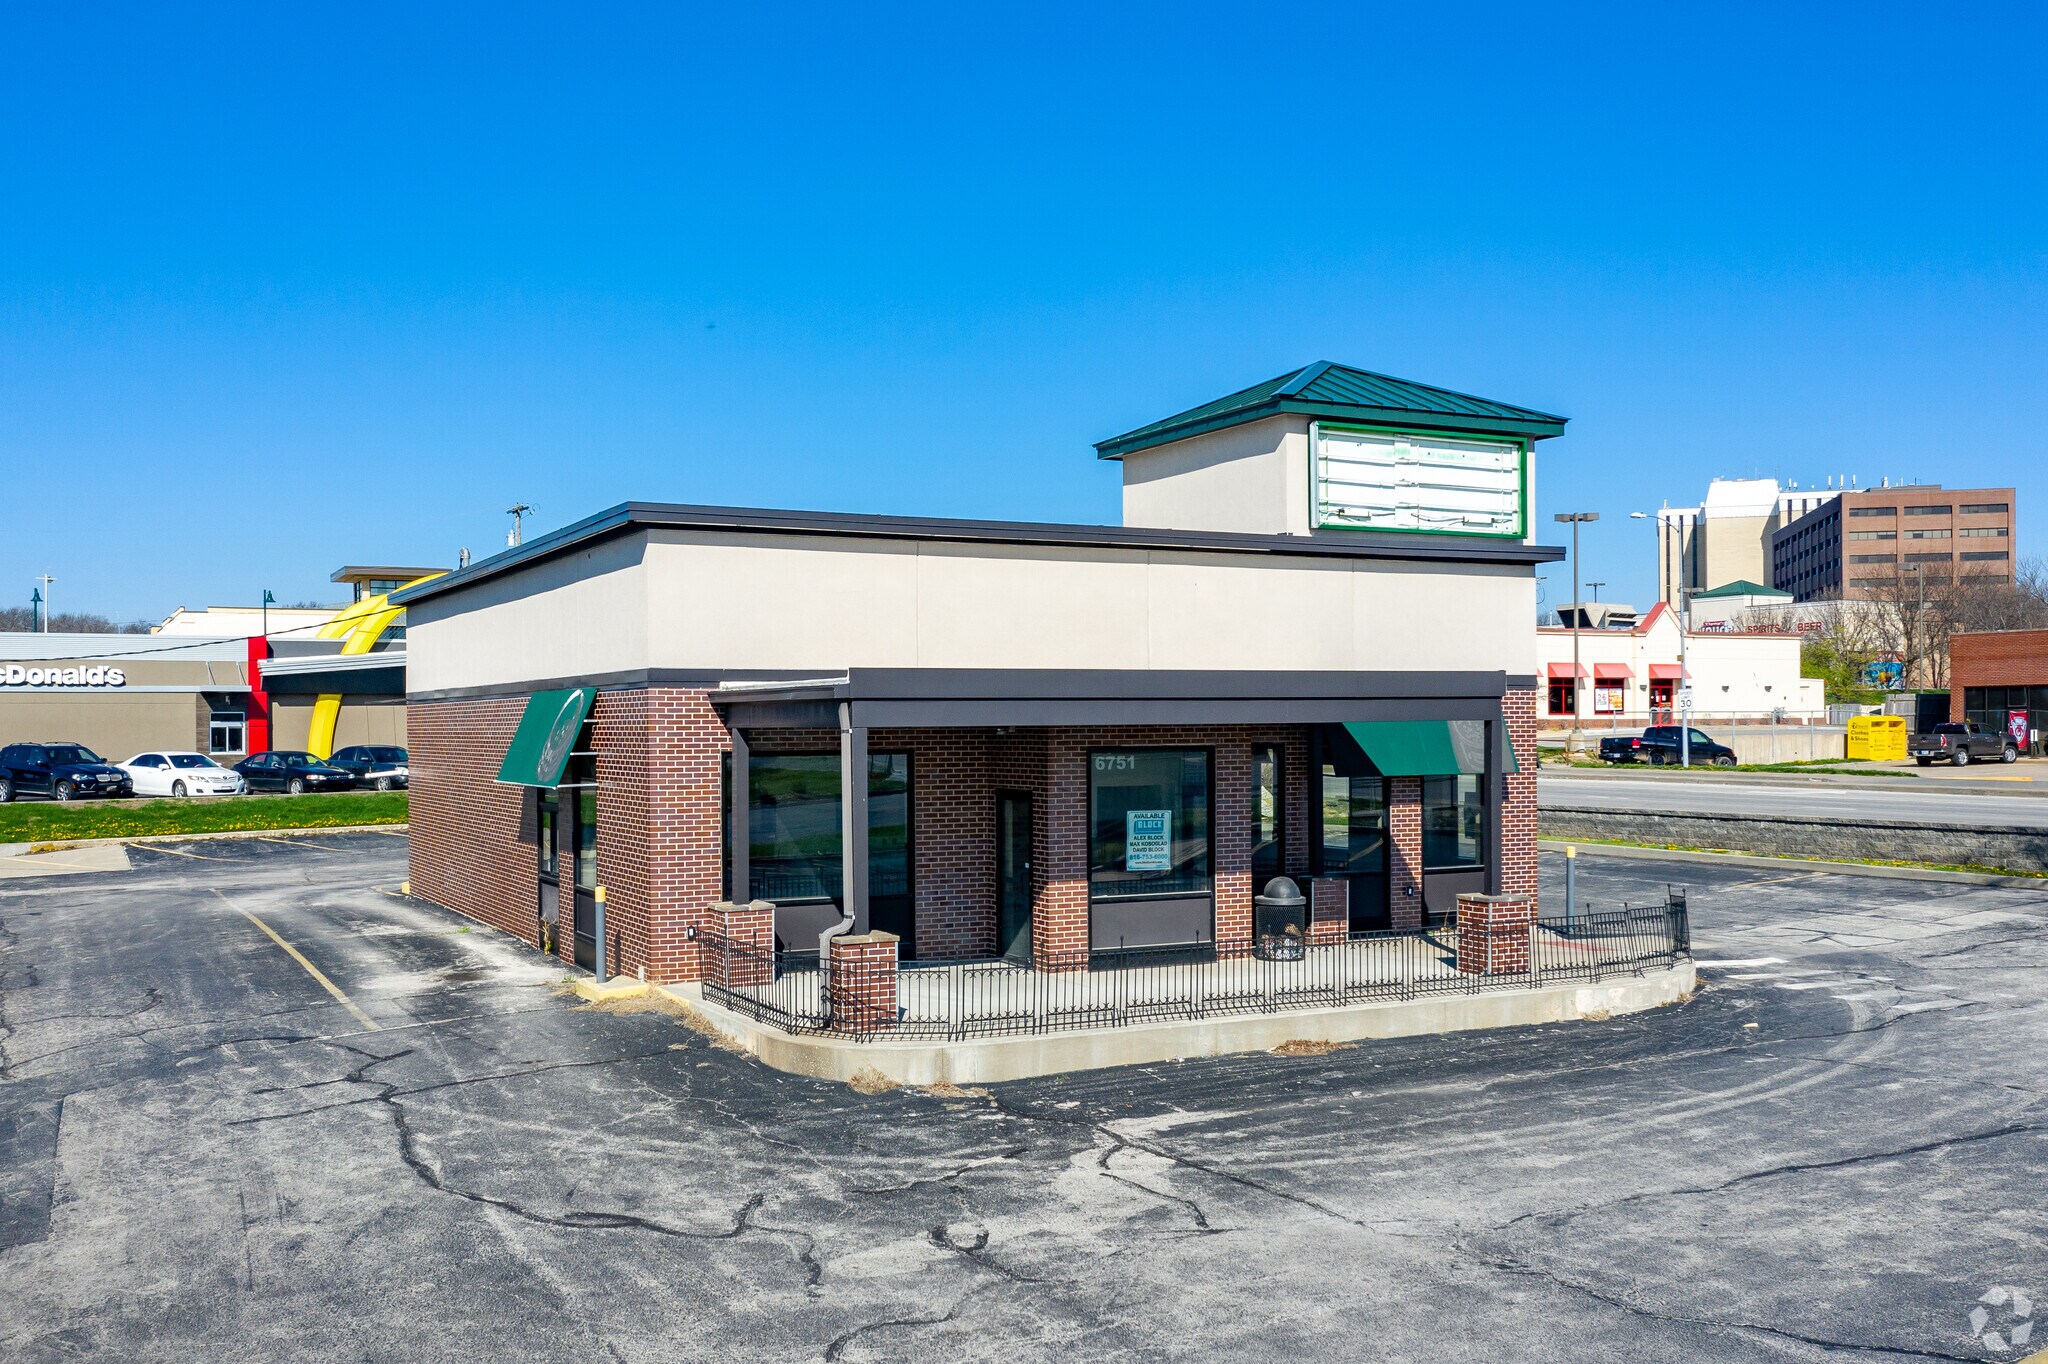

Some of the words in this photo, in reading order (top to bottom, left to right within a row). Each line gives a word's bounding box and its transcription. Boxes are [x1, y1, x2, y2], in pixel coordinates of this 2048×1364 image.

[1797, 622, 1821, 632] BEER
[1680, 699, 1692, 708] 30
[1095, 755, 1134, 770] 6751
